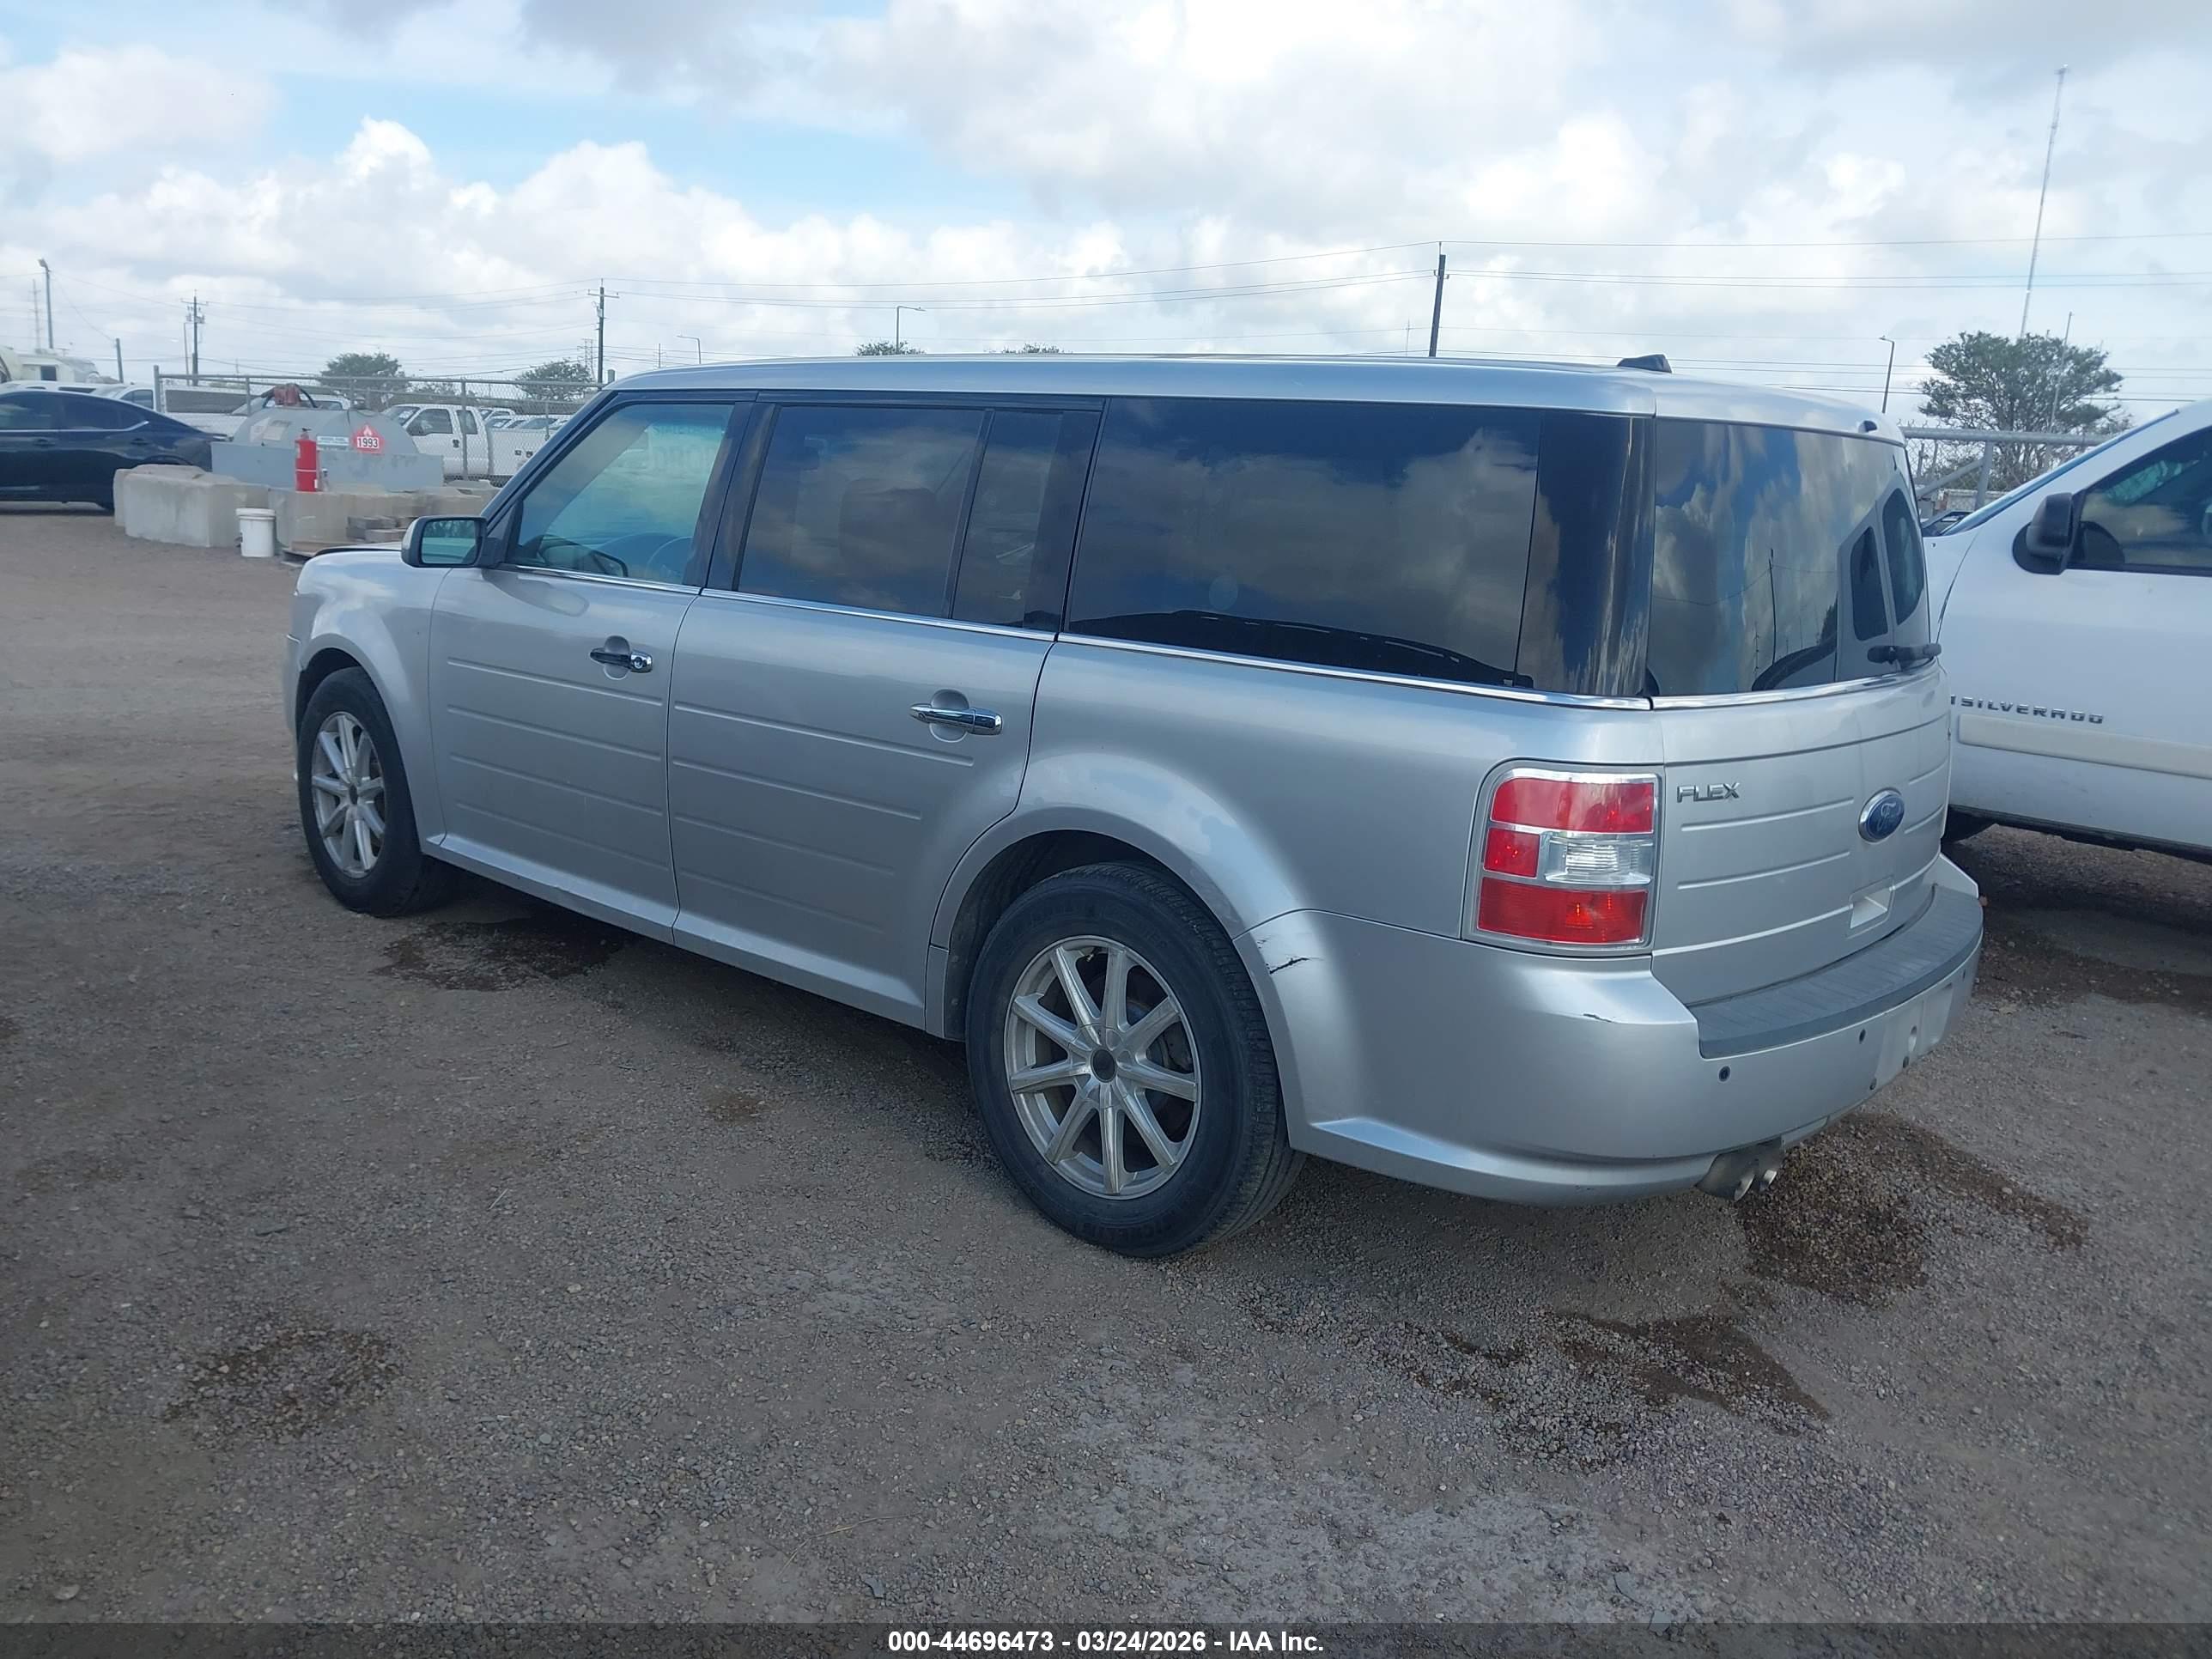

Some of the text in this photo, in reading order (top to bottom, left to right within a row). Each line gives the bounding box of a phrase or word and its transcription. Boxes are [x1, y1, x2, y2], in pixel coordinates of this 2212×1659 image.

[358, 438, 378, 447] 1993
[1960, 696, 2103, 724] SILVERADO
[1677, 782, 1740, 803] FLEX
